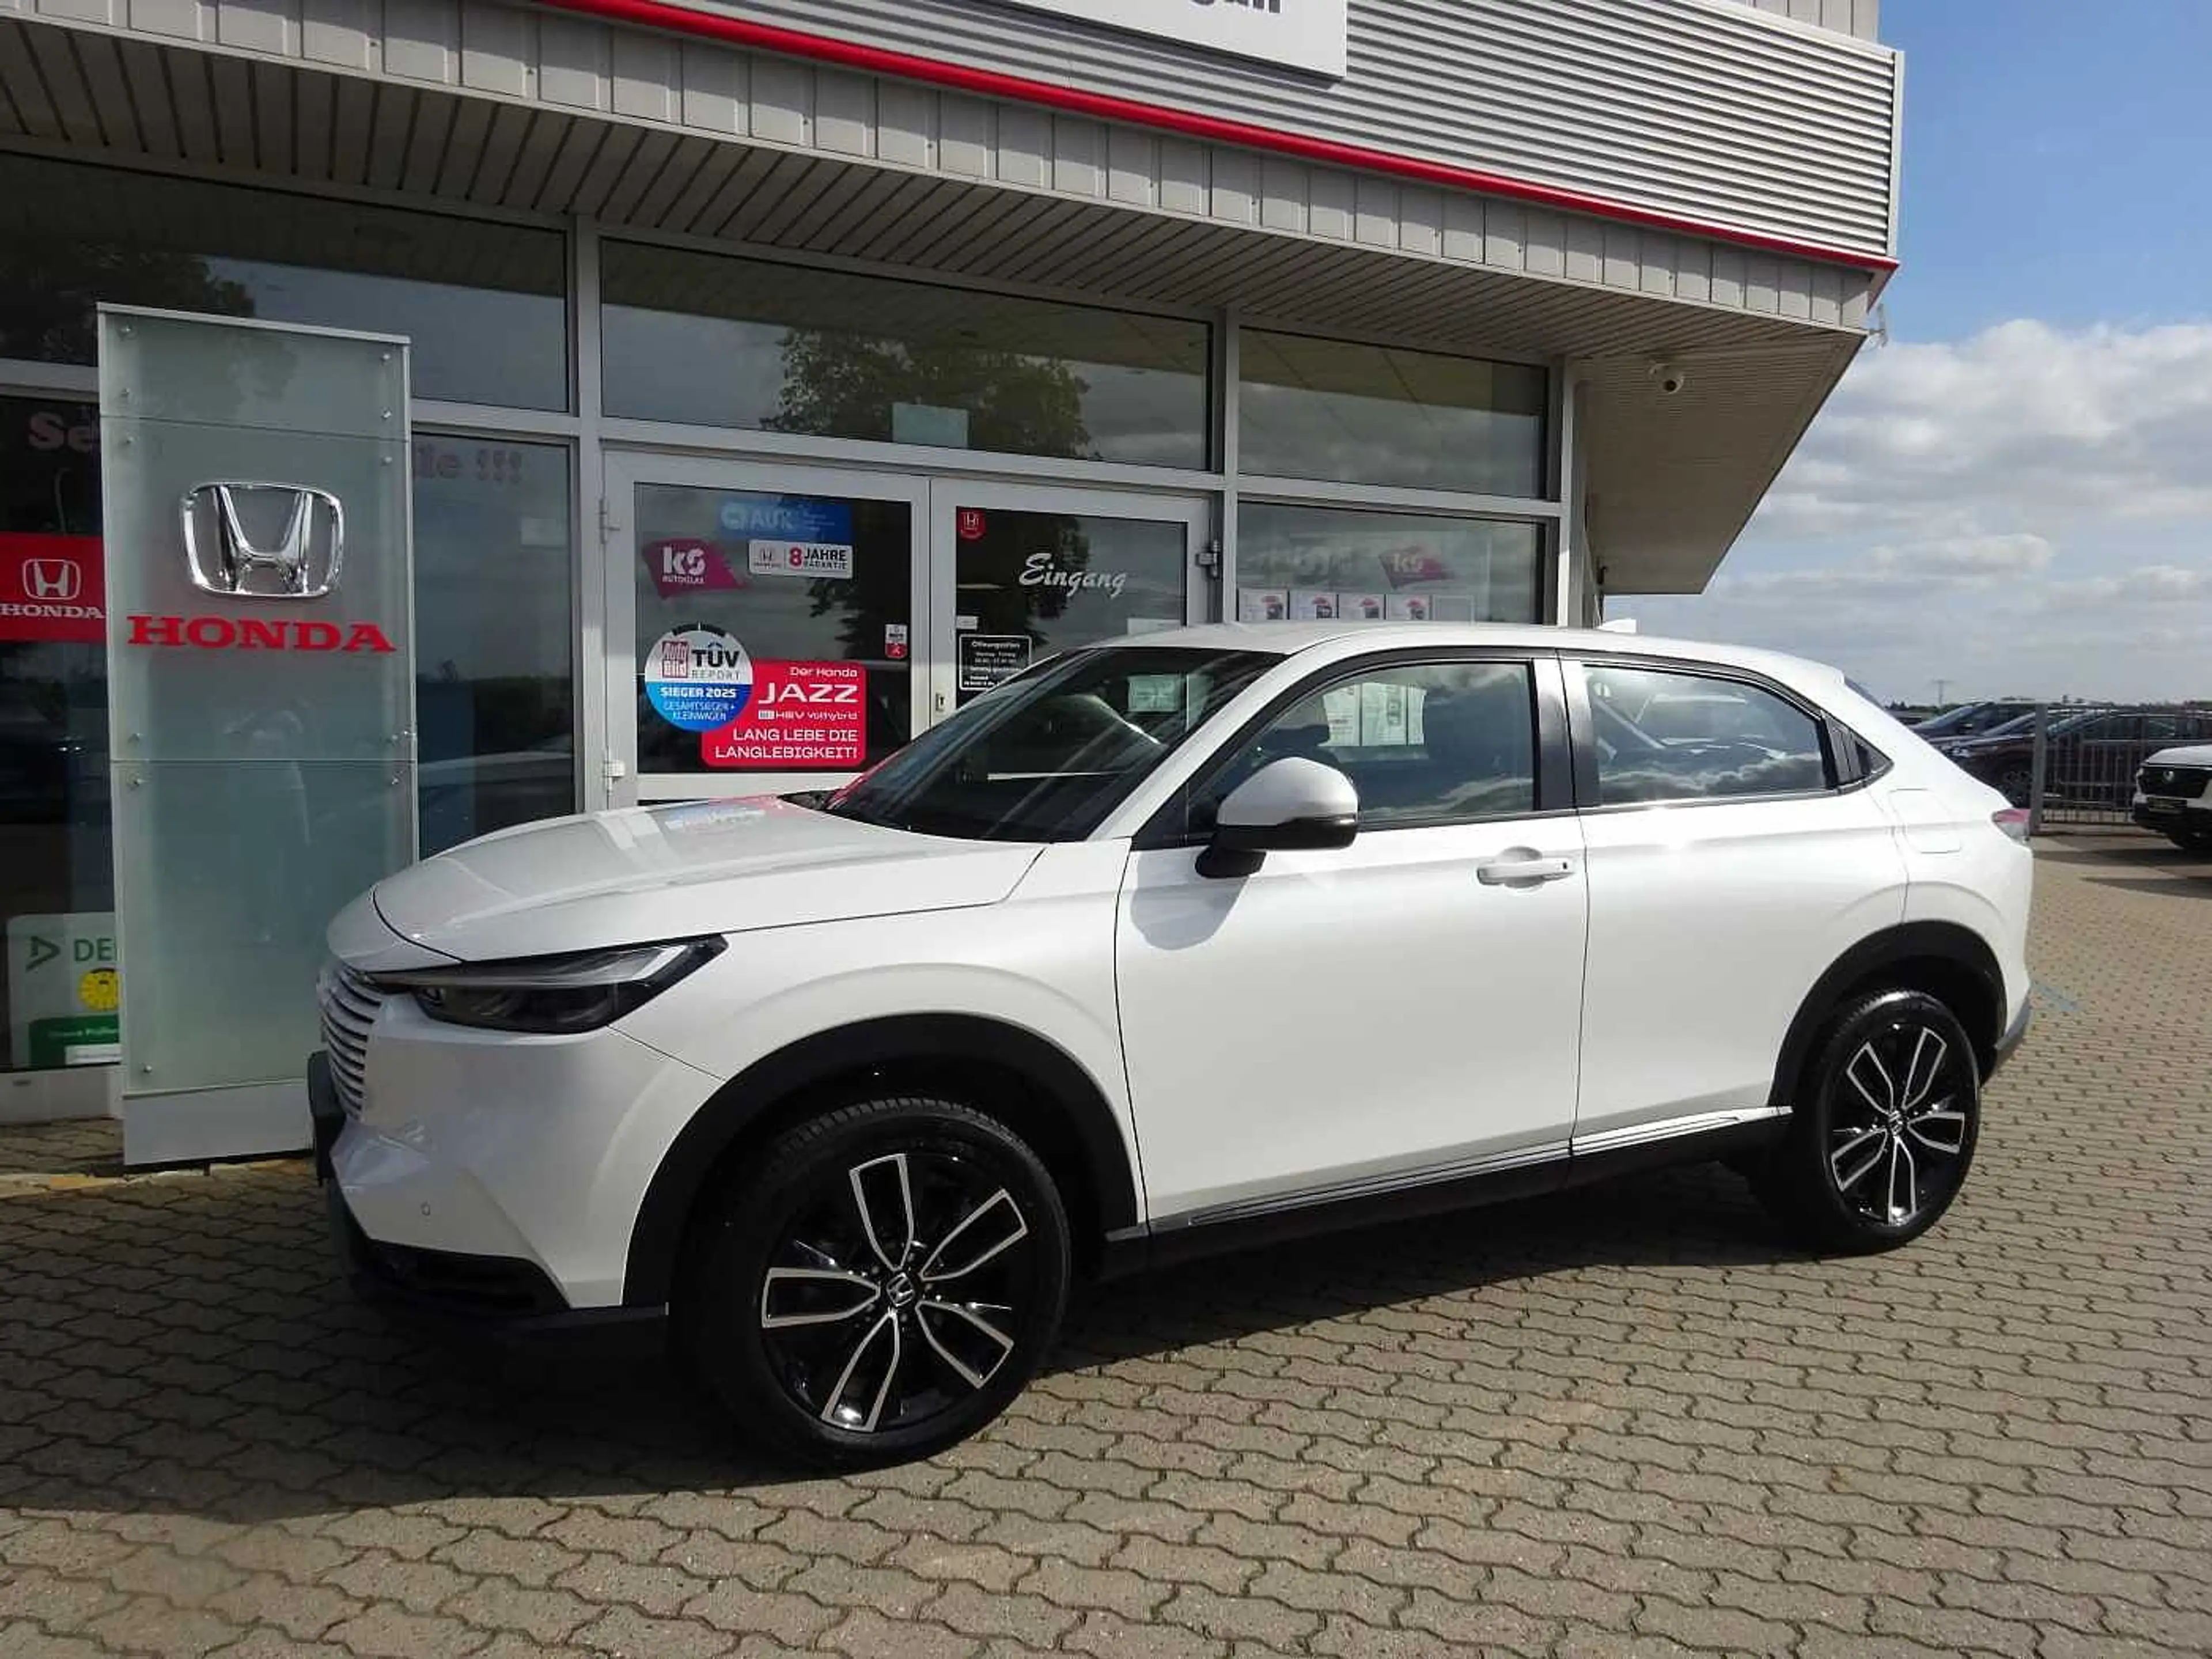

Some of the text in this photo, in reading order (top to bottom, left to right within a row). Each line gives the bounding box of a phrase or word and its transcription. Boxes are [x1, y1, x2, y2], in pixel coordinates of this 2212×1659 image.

[790, 548, 847, 567] 8 JAHRE
[1019, 553, 1126, 599] Eingang
[1, 603, 106, 620] HONDA
[127, 615, 397, 653] HONDA
[790, 667, 858, 677] Der Honda
[661, 687, 737, 699] SIEGER 2025
[758, 682, 858, 704] JAZZ
[733, 728, 858, 742] LANG LEBE DIE
[715, 745, 858, 759] LANGLEBIGKEIT!
